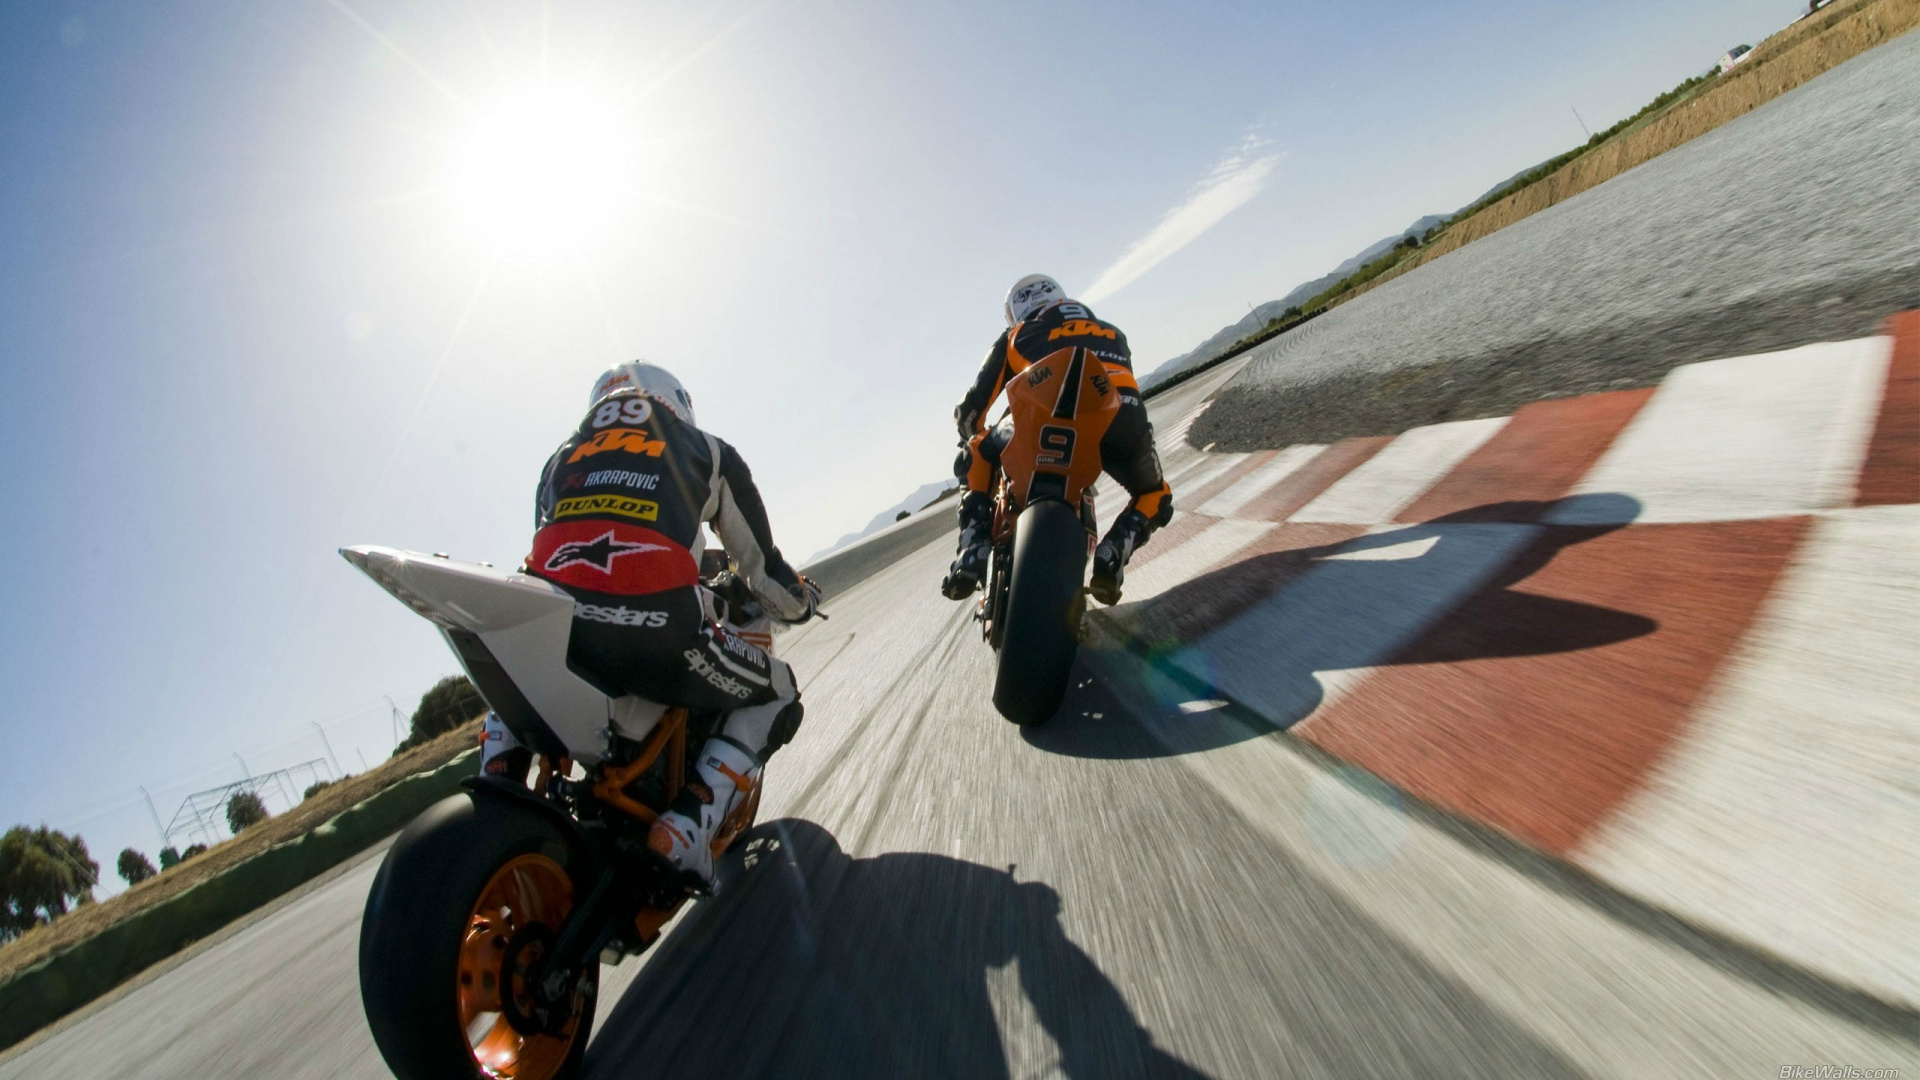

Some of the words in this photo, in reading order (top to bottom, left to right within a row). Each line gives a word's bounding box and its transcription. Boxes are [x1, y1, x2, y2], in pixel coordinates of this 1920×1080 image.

[1058, 303, 1090, 320] 9
[1047, 319, 1116, 342] KTM
[1028, 366, 1053, 388] KTM
[1090, 374, 1109, 397] KTM
[591, 398, 653, 428] 89
[565, 427, 667, 465] KTM
[1036, 424, 1078, 468] 9
[555, 498, 655, 514] DUNLOP
[573, 601, 669, 628] estars
